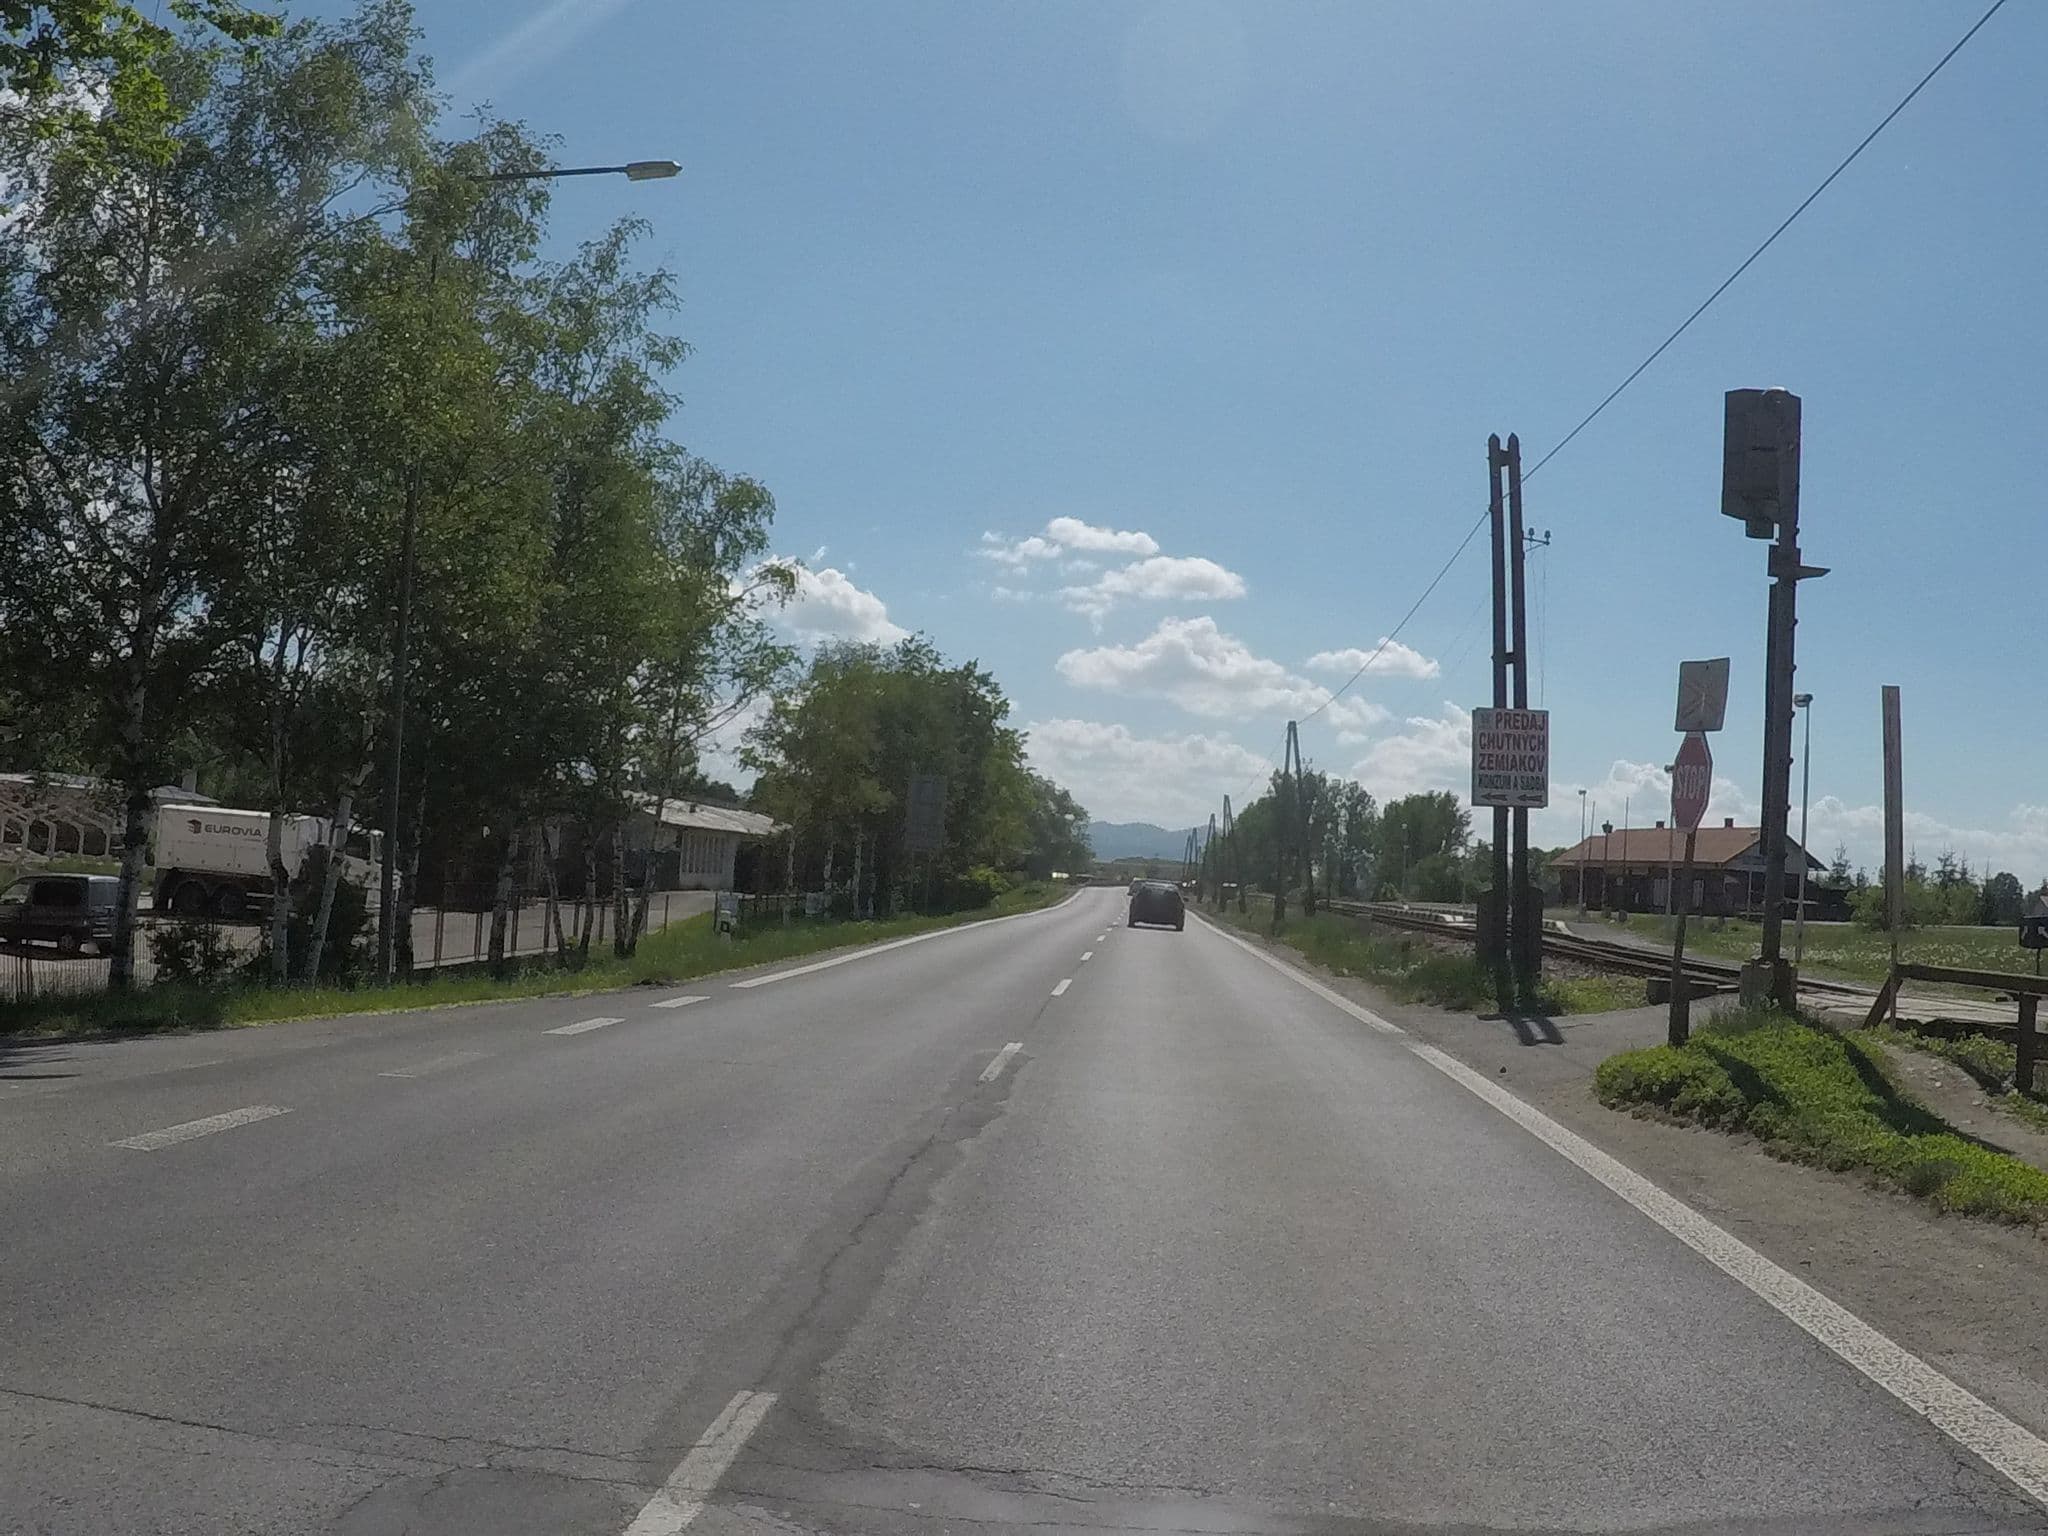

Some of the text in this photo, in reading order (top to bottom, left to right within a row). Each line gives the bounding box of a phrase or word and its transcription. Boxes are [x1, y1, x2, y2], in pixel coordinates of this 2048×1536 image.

[1495, 712, 1546, 731] PREDAJ
[1479, 753, 1546, 773] ZEMIAKOV
[1676, 765, 1706, 800] STOP
[204, 823, 262, 837] EUROVIA
